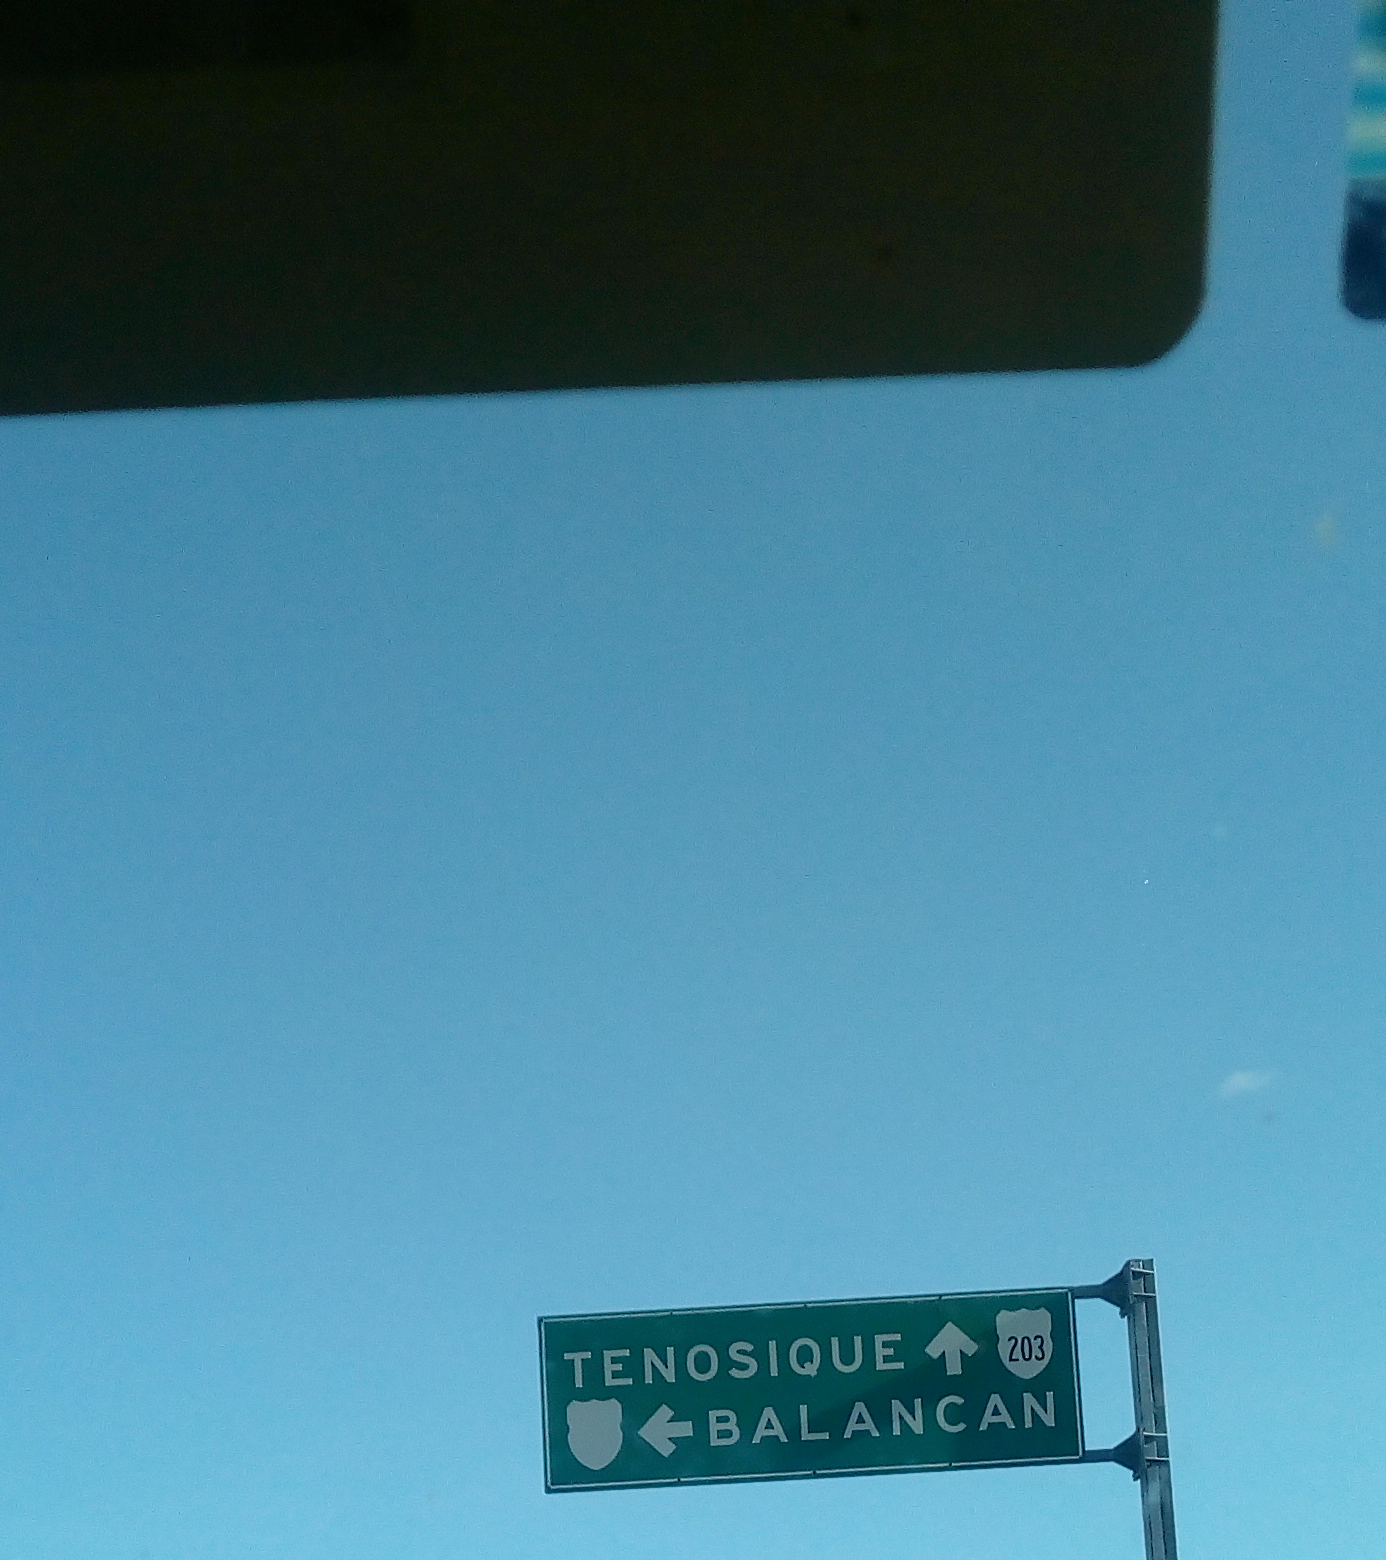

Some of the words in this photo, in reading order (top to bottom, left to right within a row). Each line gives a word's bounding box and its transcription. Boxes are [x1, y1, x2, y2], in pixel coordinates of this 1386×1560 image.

[563, 1332, 906, 1388] TENOSIQUE
[1007, 1334, 1046, 1363] 203
[708, 1390, 1056, 1447] BALANCAN
